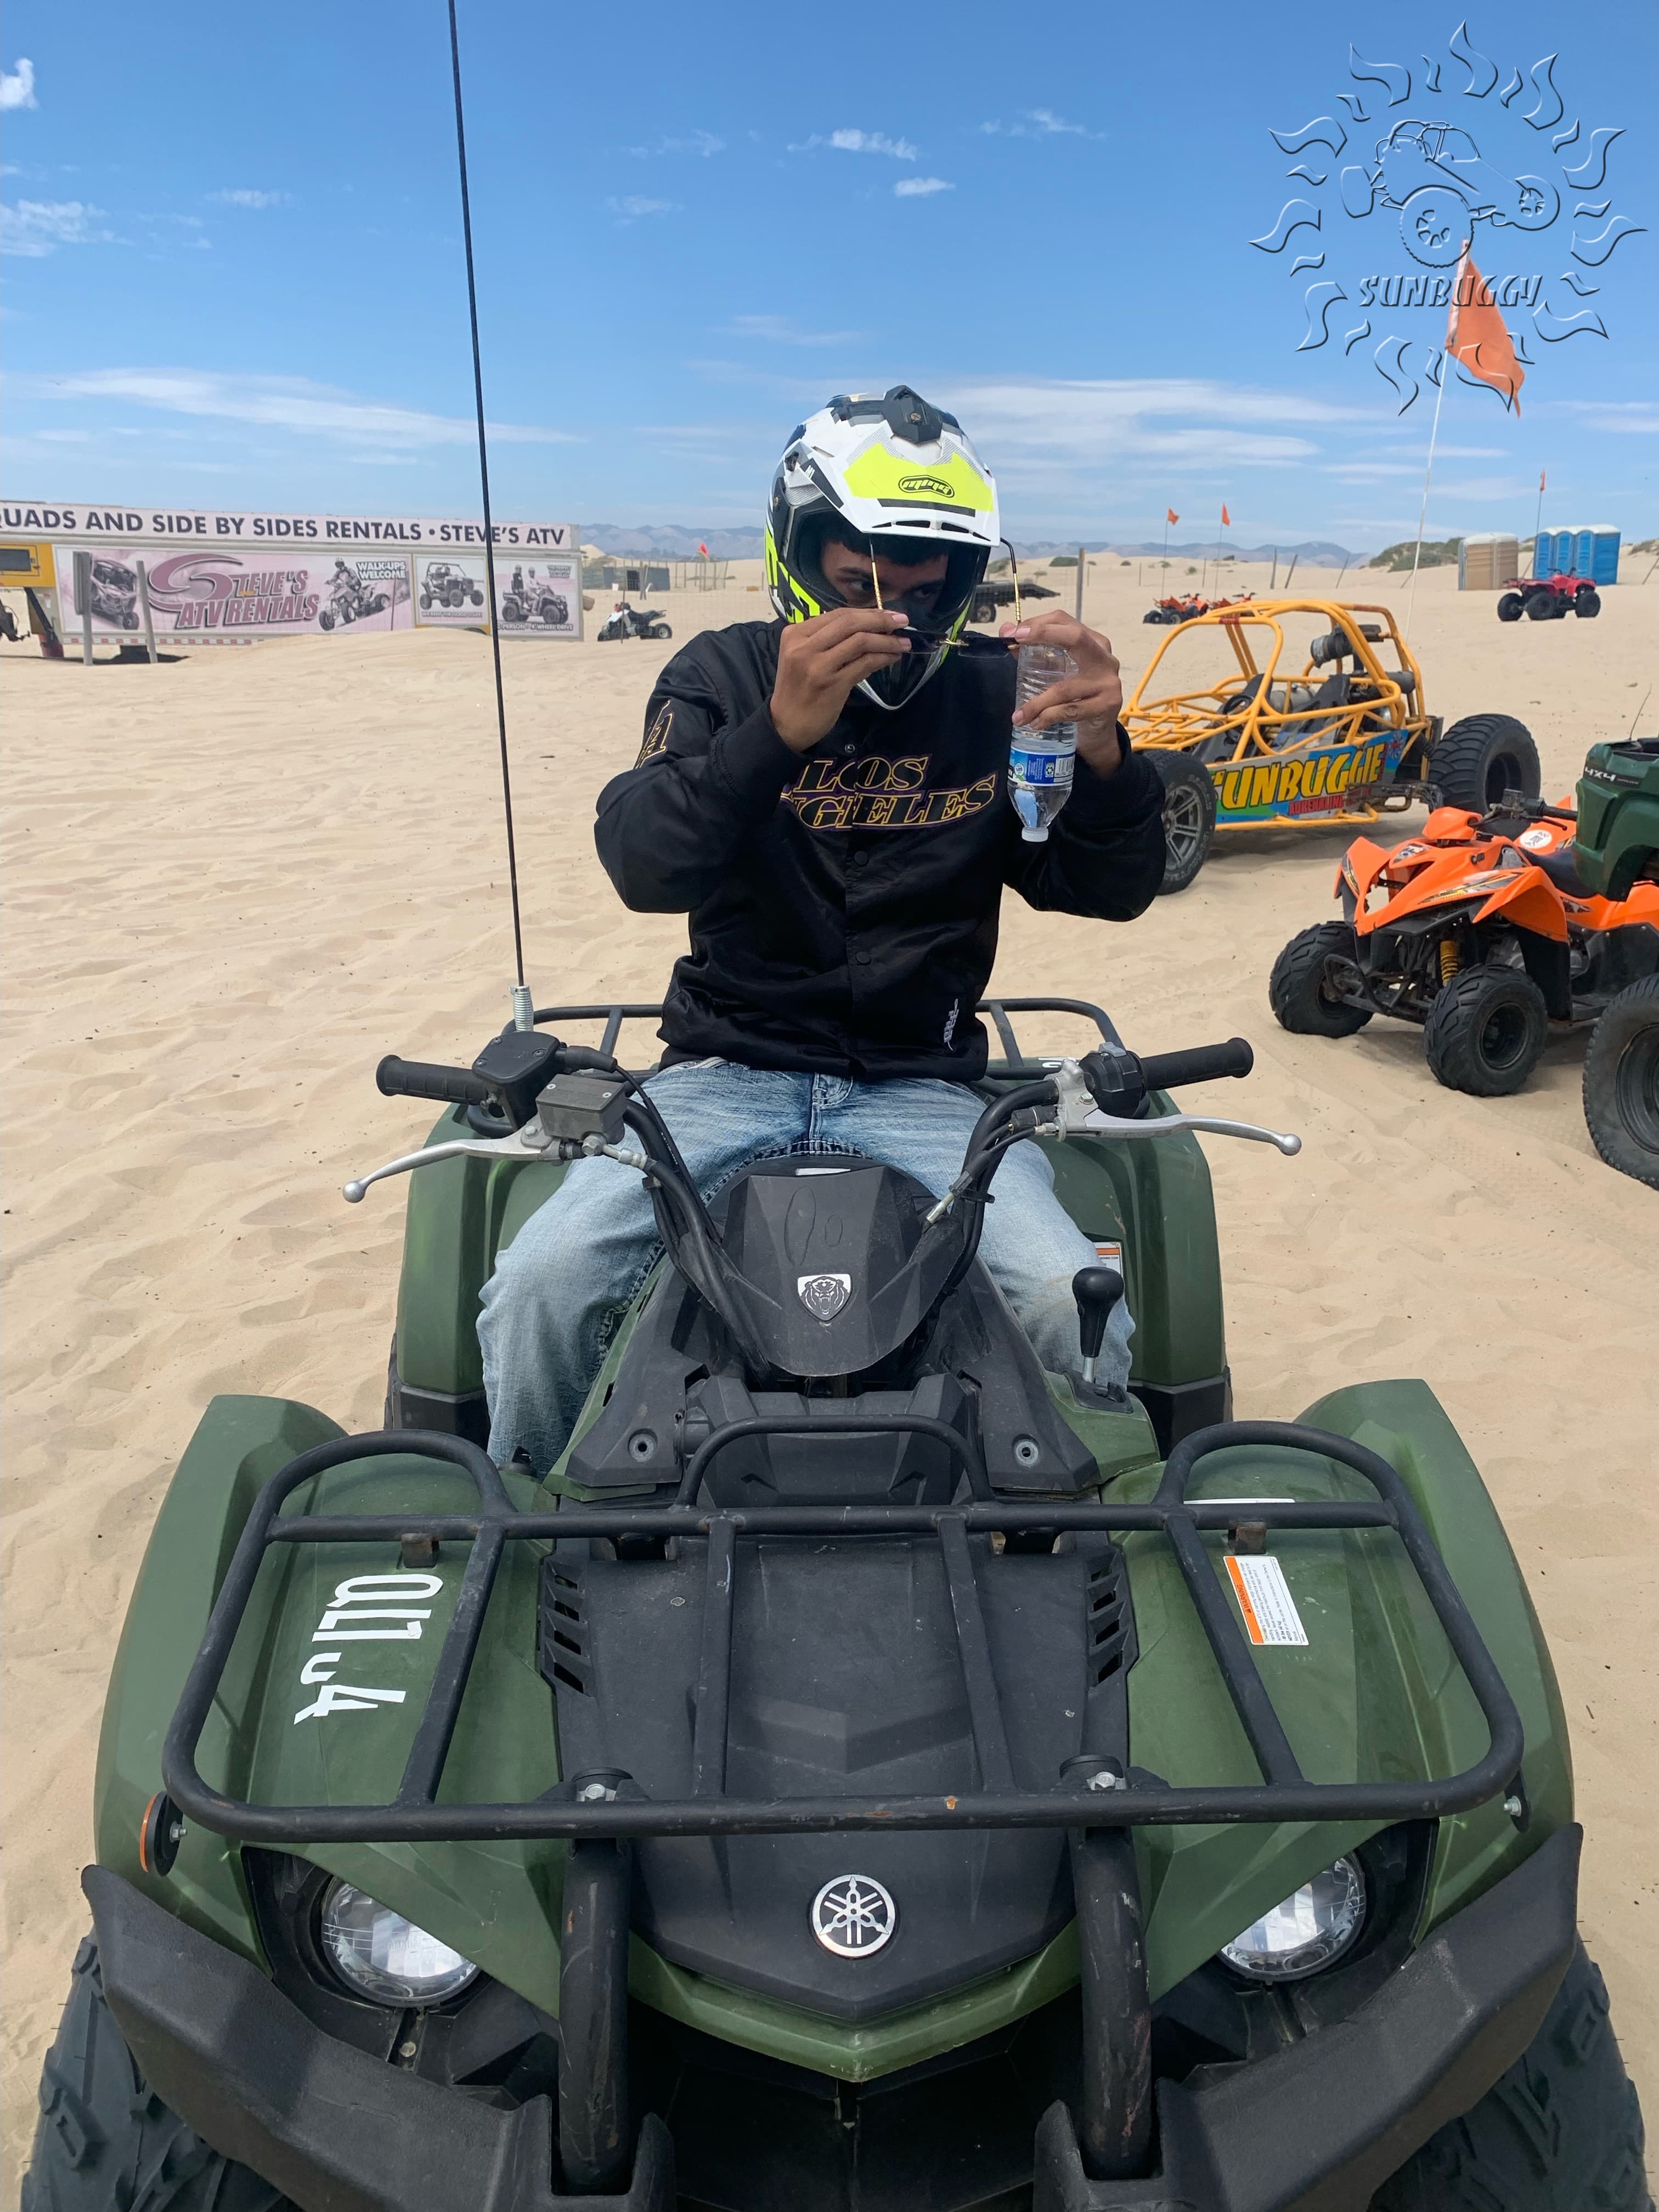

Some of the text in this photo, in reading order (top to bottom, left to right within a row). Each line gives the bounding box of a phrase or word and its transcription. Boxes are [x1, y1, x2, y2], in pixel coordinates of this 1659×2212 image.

[0, 508, 76, 529] UADS
[86, 511, 144, 532] AND
[152, 514, 207, 534] SIDE
[215, 516, 245, 535] BY
[253, 518, 318, 538] SIDES
[326, 520, 422, 540] RENTALS
[526, 528, 565, 545] ATV
[356, 561, 406, 571] WALK-UPS
[359, 571, 407, 579] WELCOME
[175, 594, 320, 629] ATV RENTALS
[793, 757, 929, 793] LOS
[780, 774, 996, 829] GELES
[1237, 1584, 1250, 1609] WARNING
